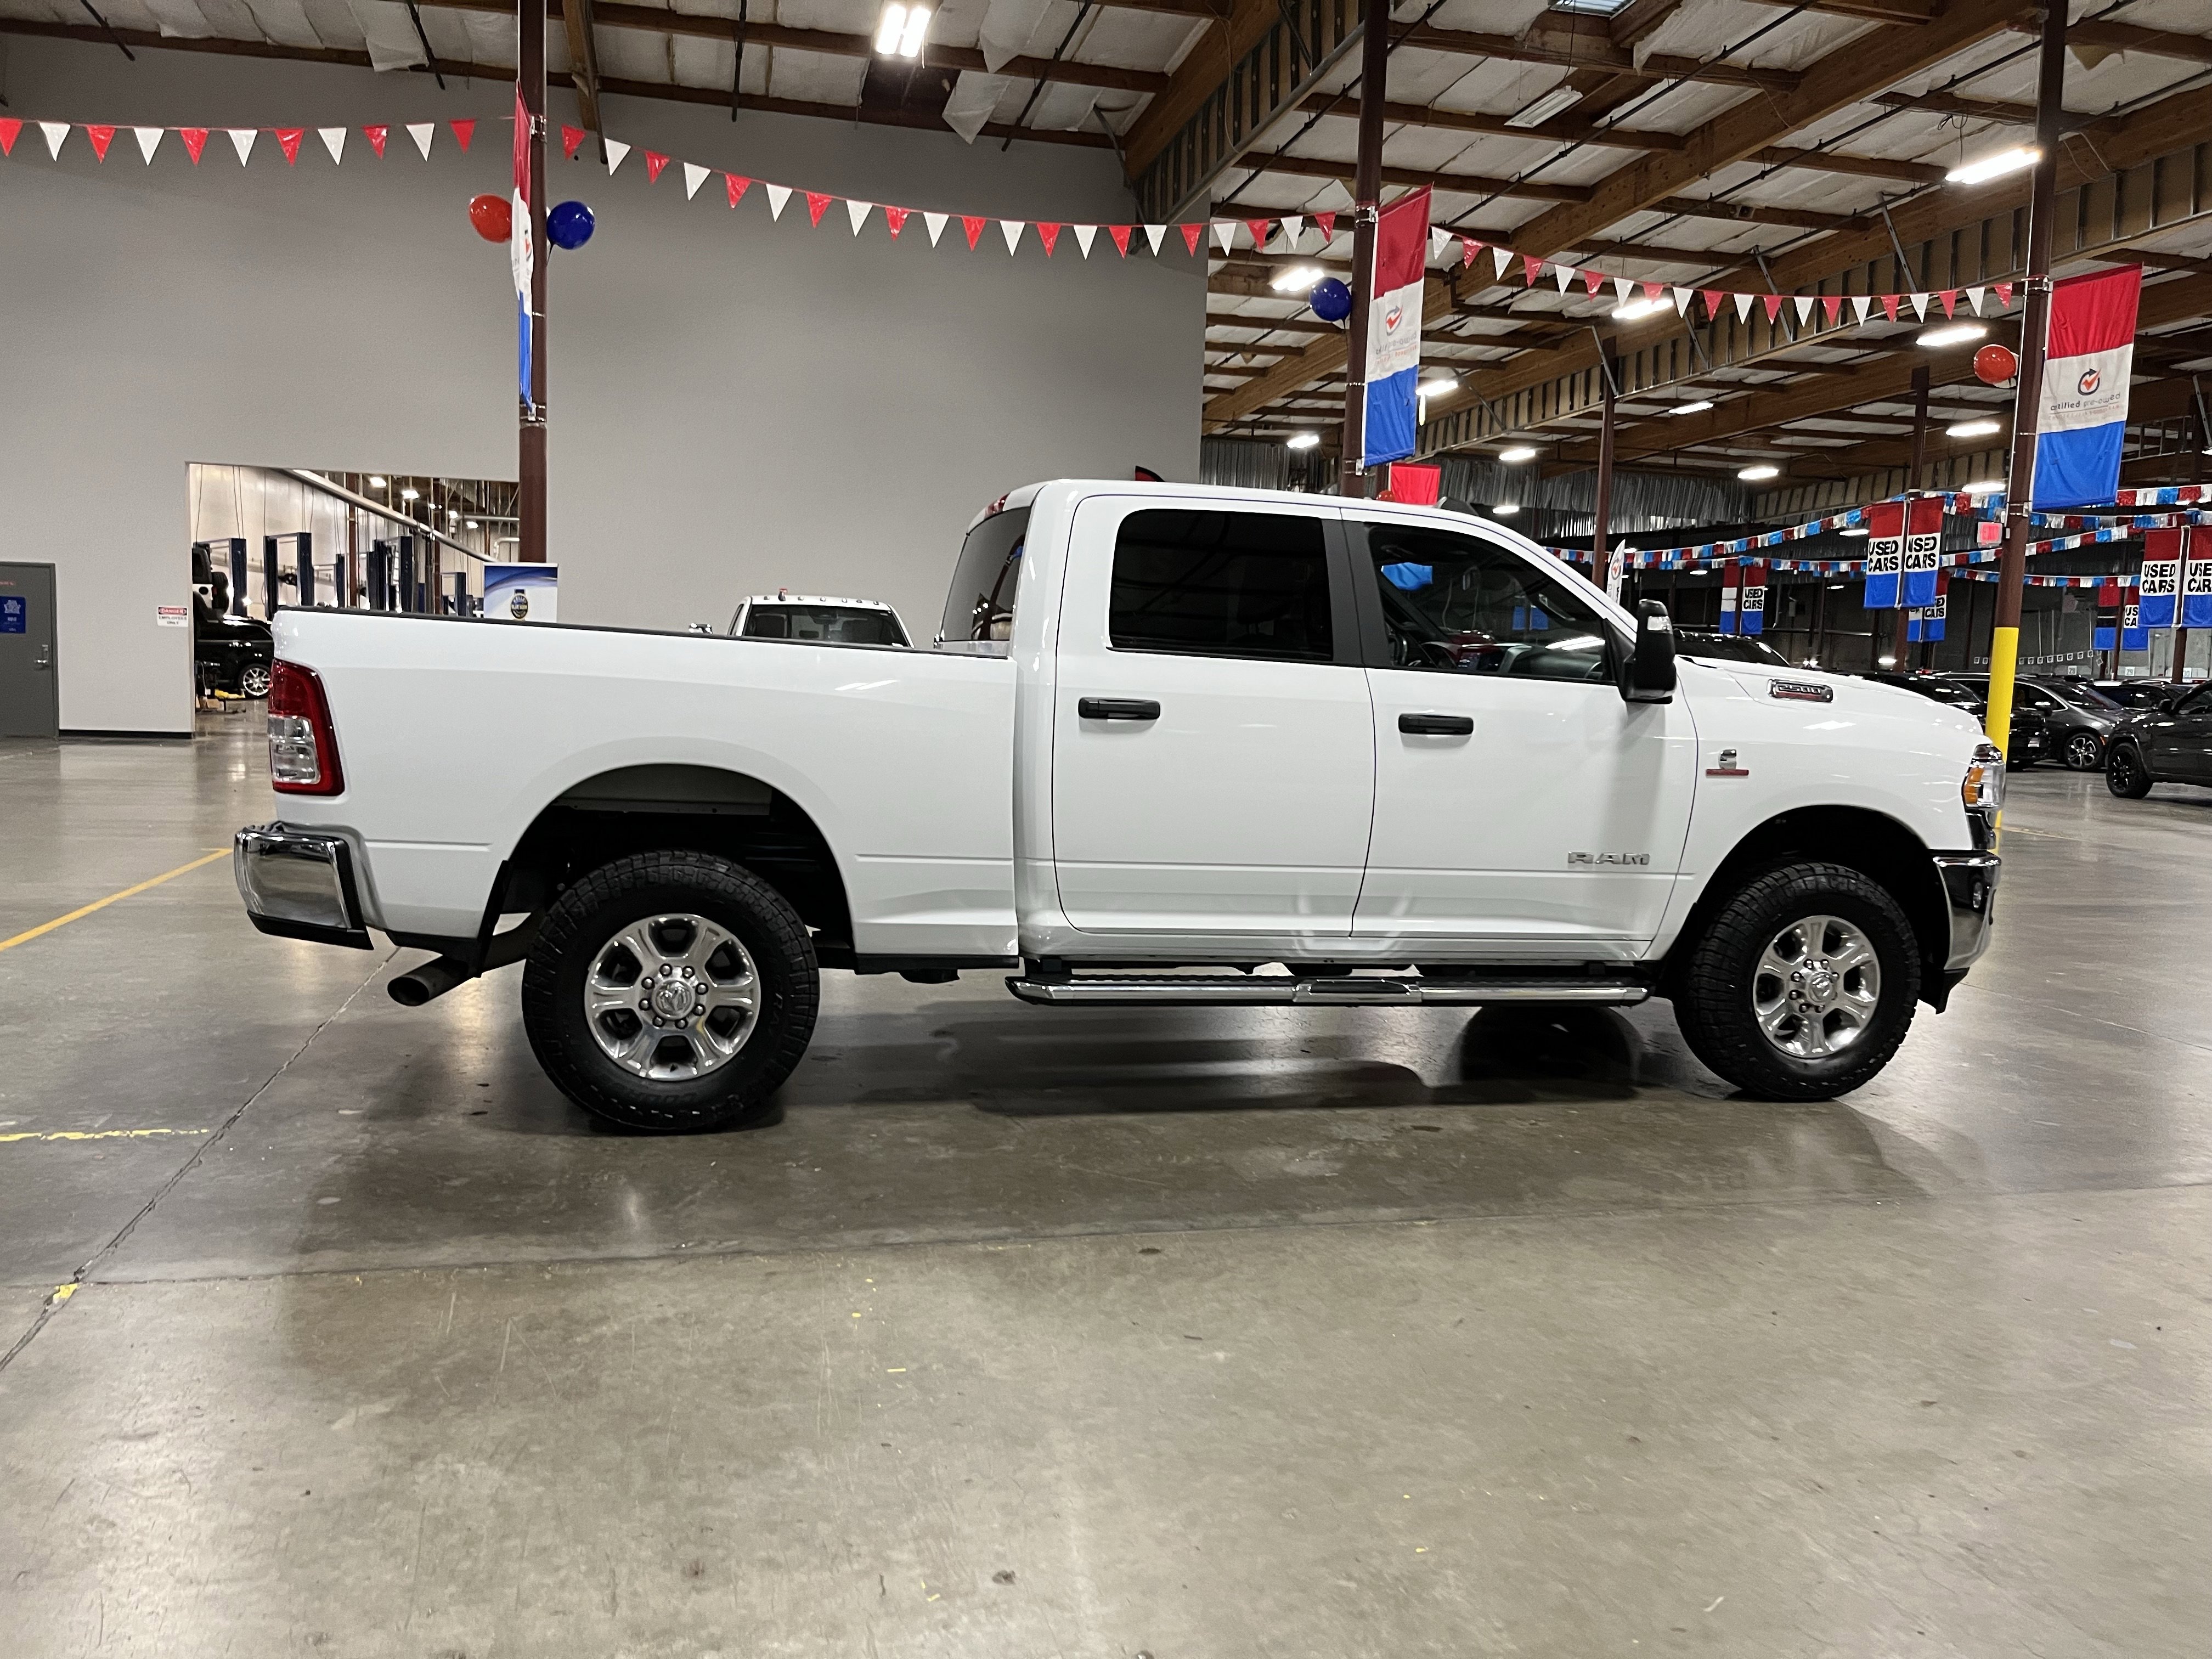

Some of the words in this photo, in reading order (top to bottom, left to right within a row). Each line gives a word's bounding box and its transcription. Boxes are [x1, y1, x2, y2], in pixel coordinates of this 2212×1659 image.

[2084, 392, 2120, 408] pre-owed
[1869, 540, 1899, 556] USED
[1908, 536, 1937, 552] USED
[1869, 556, 1899, 572] CARS
[1906, 553, 1936, 569] CARS
[2144, 563, 2176, 578] USED
[2190, 562, 2212, 577] USE
[2142, 579, 2175, 593] CARS
[2187, 578, 2212, 592] CAR
[1745, 588, 1763, 598] USED
[2125, 606, 2138, 617] US
[2124, 617, 2137, 627] CA
[1568, 851, 1651, 866] RAM
